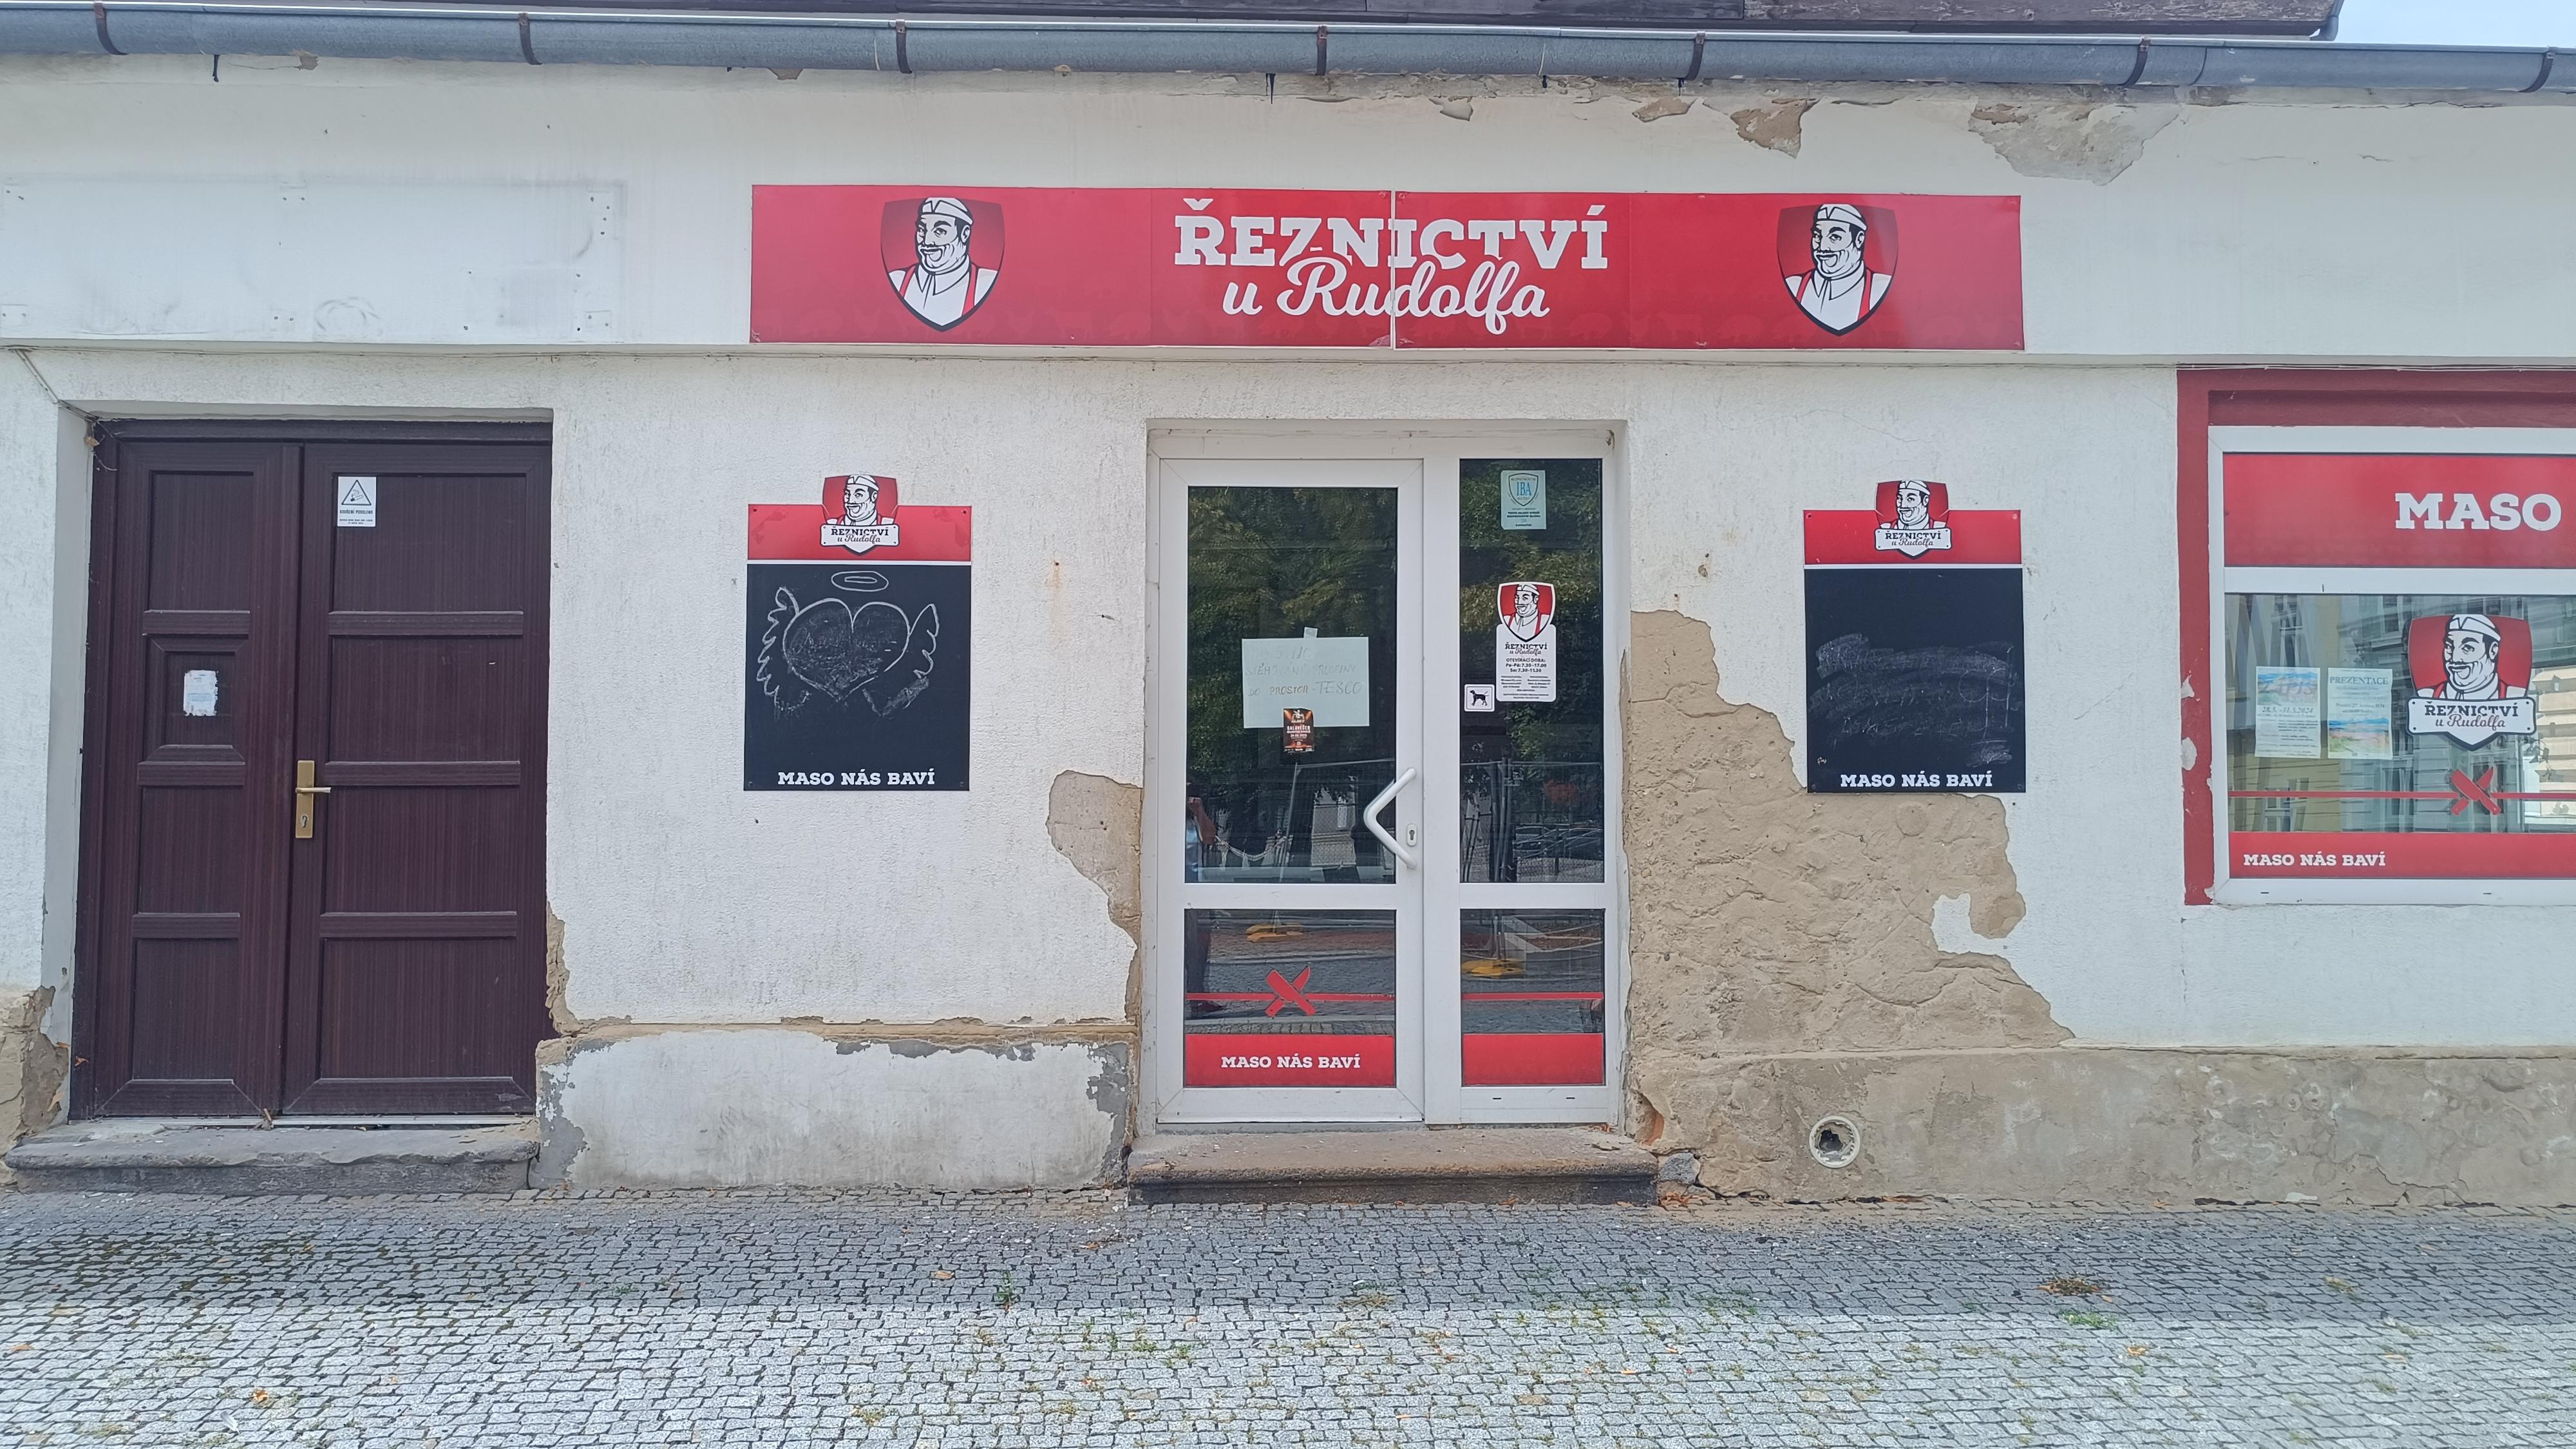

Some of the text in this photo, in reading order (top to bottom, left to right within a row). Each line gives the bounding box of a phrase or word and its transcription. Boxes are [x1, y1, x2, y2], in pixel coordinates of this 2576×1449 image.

[1174, 197, 1609, 269] ŘEZNICTVÍ
[1222, 256, 1551, 336] u Rudolfa
[1516, 482, 1531, 496] IBA
[2395, 493, 2562, 531] MASO
[831, 526, 889, 536] ŘEZNICTVÍ
[1885, 530, 1942, 540] ŘEZNICTVÍ
[845, 533, 882, 545] Rudolfa
[1899, 537, 1934, 548] Rudolfa
[1504, 641, 1548, 650] ŘEZNICTVÍ
[1515, 648, 1542, 656] Rudolfa
[2329, 676, 2389, 685] PREZENTACE
[2424, 701, 2519, 717] ŘEZNICTVÍ
[2435, 713, 2506, 732] u Rudolfa
[777, 768, 935, 786] MASO NÁS BAVÍ
[1840, 770, 1993, 788] MASO NÁS BAVÍ
[2243, 851, 2386, 866] MASO NÁS BAVÍ
[1221, 1053, 1361, 1068] MASO NÁS BAVÍ
